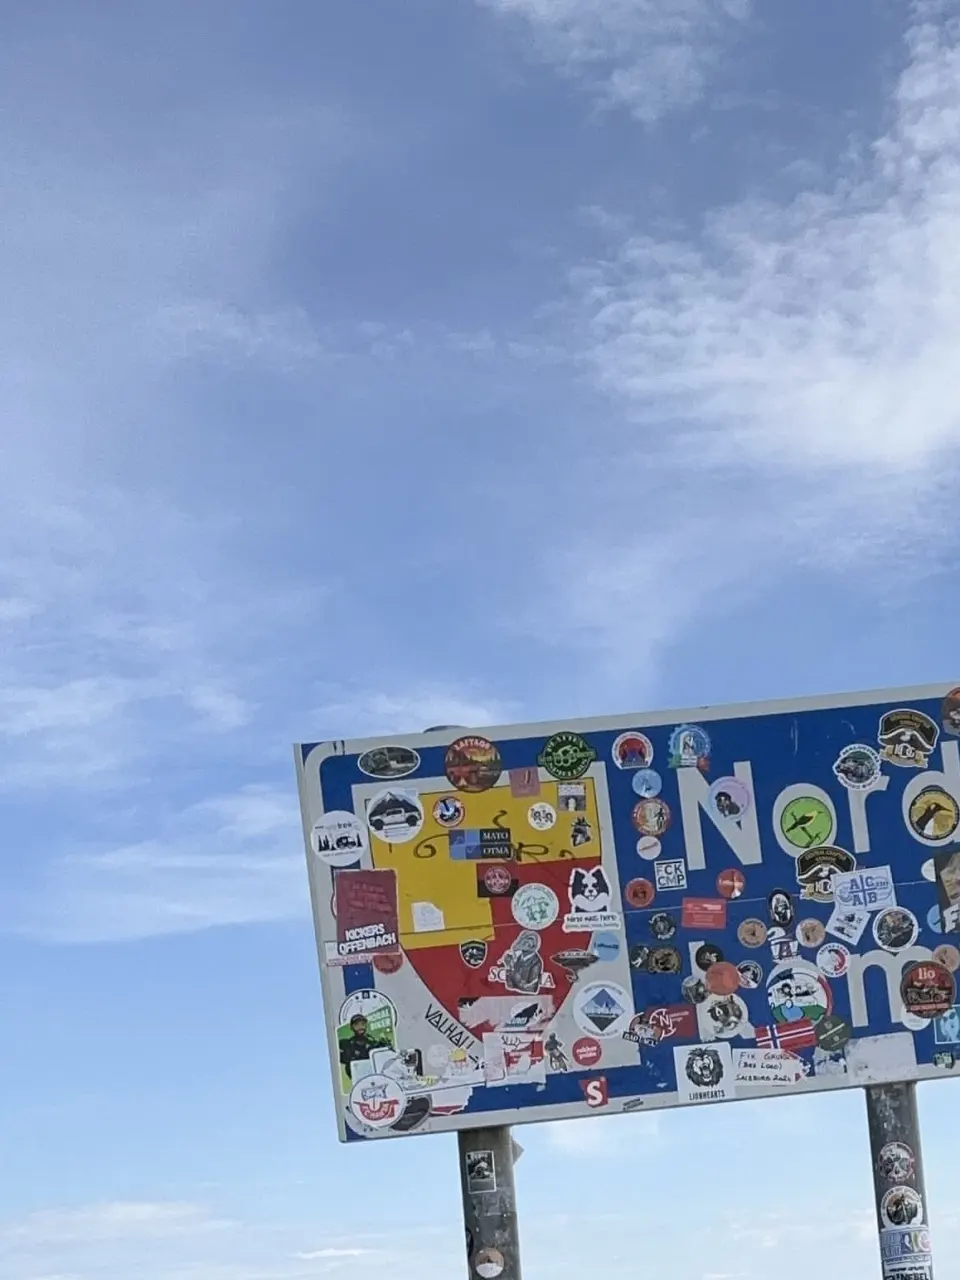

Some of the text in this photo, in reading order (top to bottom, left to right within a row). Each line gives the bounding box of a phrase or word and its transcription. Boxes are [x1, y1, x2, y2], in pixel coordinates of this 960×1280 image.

[345, 923, 385, 941] KICKERS
[339, 933, 397, 955] OFFENBACH
[688, 1090, 726, 1101] LIONHEARTS
